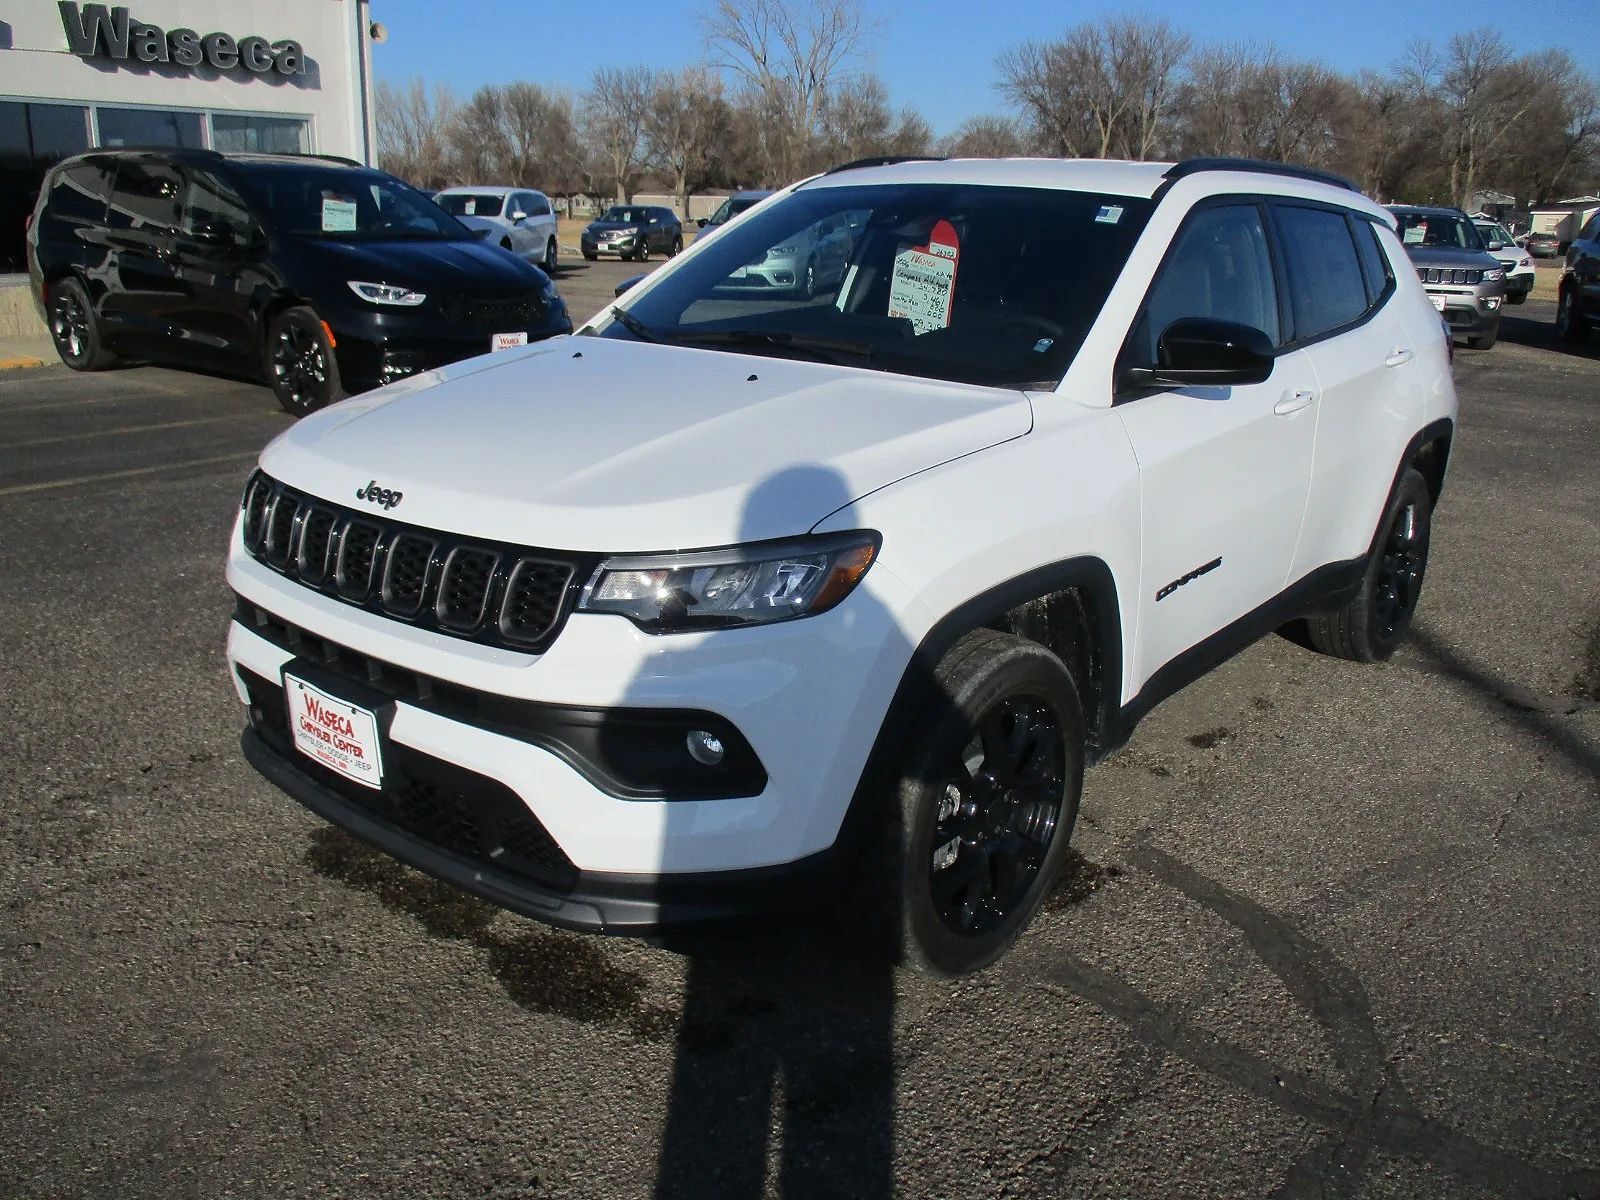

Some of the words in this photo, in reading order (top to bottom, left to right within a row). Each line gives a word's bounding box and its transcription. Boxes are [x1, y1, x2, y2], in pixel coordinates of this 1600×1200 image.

[58, 0, 306, 75] Waseca
[357, 480, 403, 511] Jeep
[304, 693, 354, 738] WASECA
[300, 716, 332, 745] CHRYSLER
[333, 734, 364, 759] CENTER
[355, 759, 372, 772] JEEP
